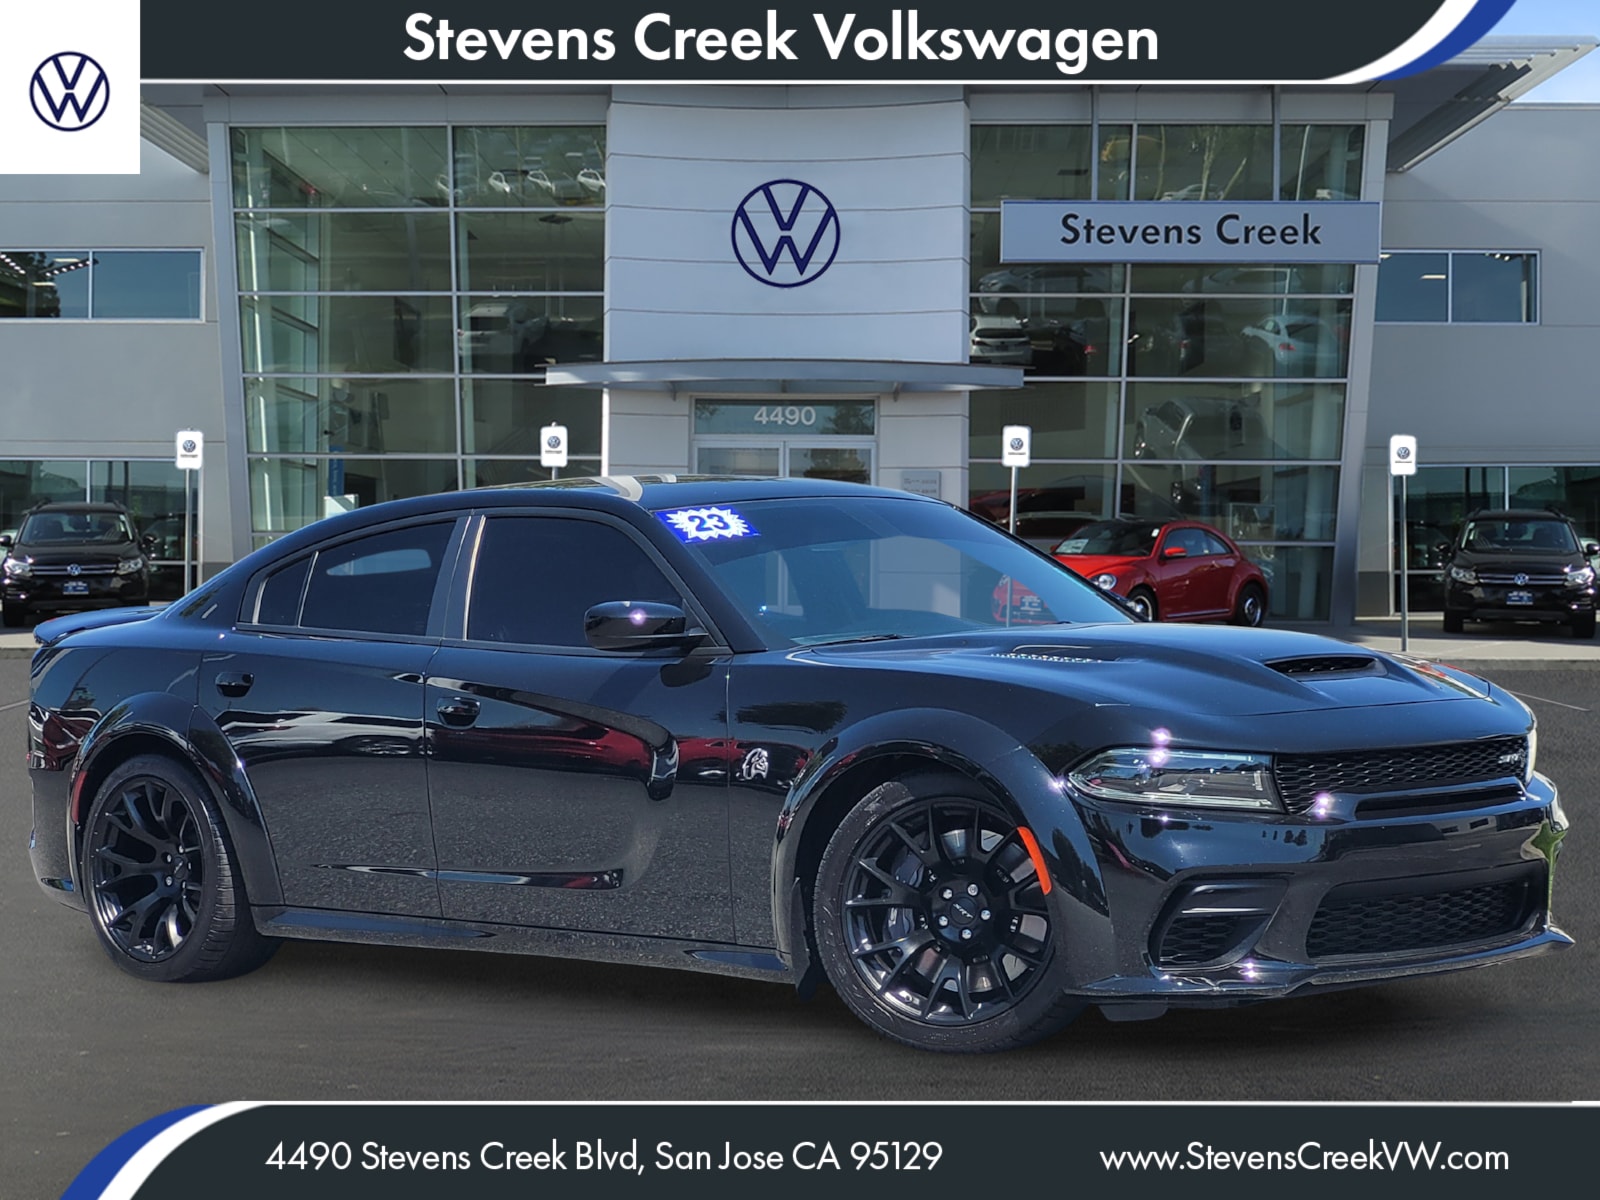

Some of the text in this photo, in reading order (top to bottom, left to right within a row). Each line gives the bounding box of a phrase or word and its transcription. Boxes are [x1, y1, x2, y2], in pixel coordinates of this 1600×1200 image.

[1060, 212, 1322, 246] Stevens Creek
[753, 405, 817, 426] 4490
[687, 513, 732, 533] 23
